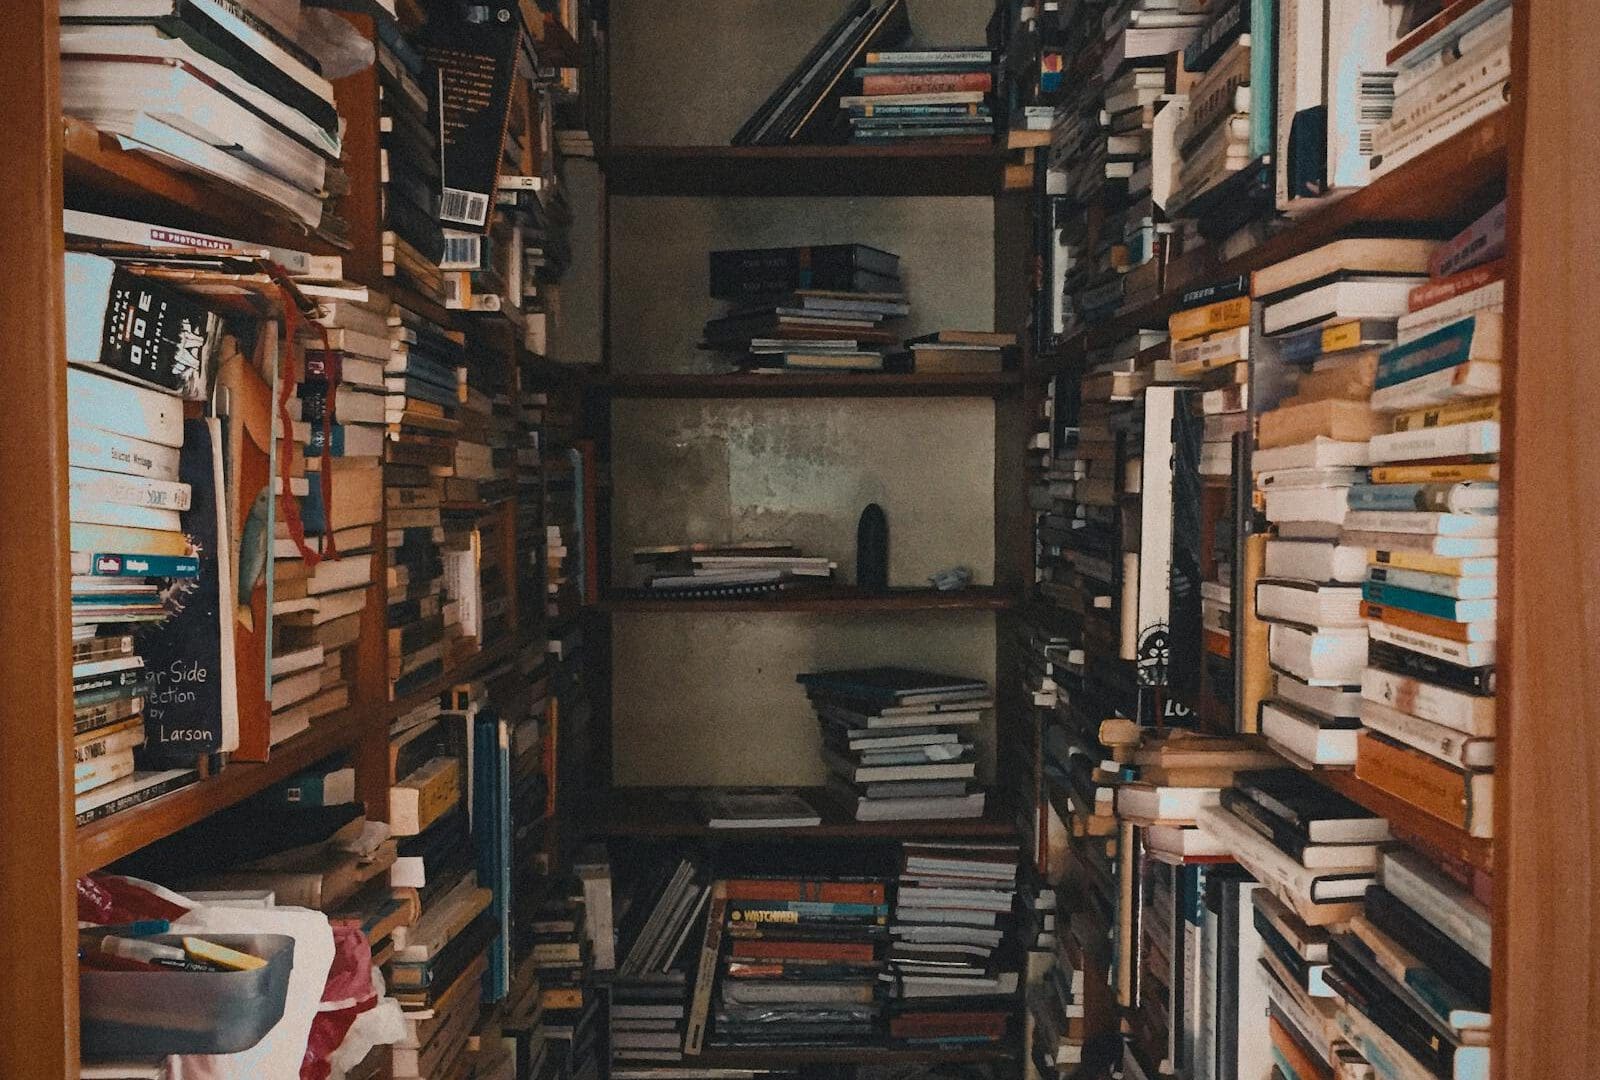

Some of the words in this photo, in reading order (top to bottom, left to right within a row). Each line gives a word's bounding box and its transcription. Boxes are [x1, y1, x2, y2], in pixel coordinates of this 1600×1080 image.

[168, 234, 230, 250] PHOTOGRAPHY
[109, 290, 122, 345] OSAMU
[116, 291, 130, 350] TEZUKA
[130, 291, 152, 365] ODE
[144, 339, 151, 355] TO
[150, 301, 167, 371] KIRIHITO
[145, 670, 166, 685] ar
[170, 659, 207, 683] Side
[146, 687, 196, 704] ection
[160, 724, 213, 743] Larson
[744, 910, 798, 924] WATCHMEN
